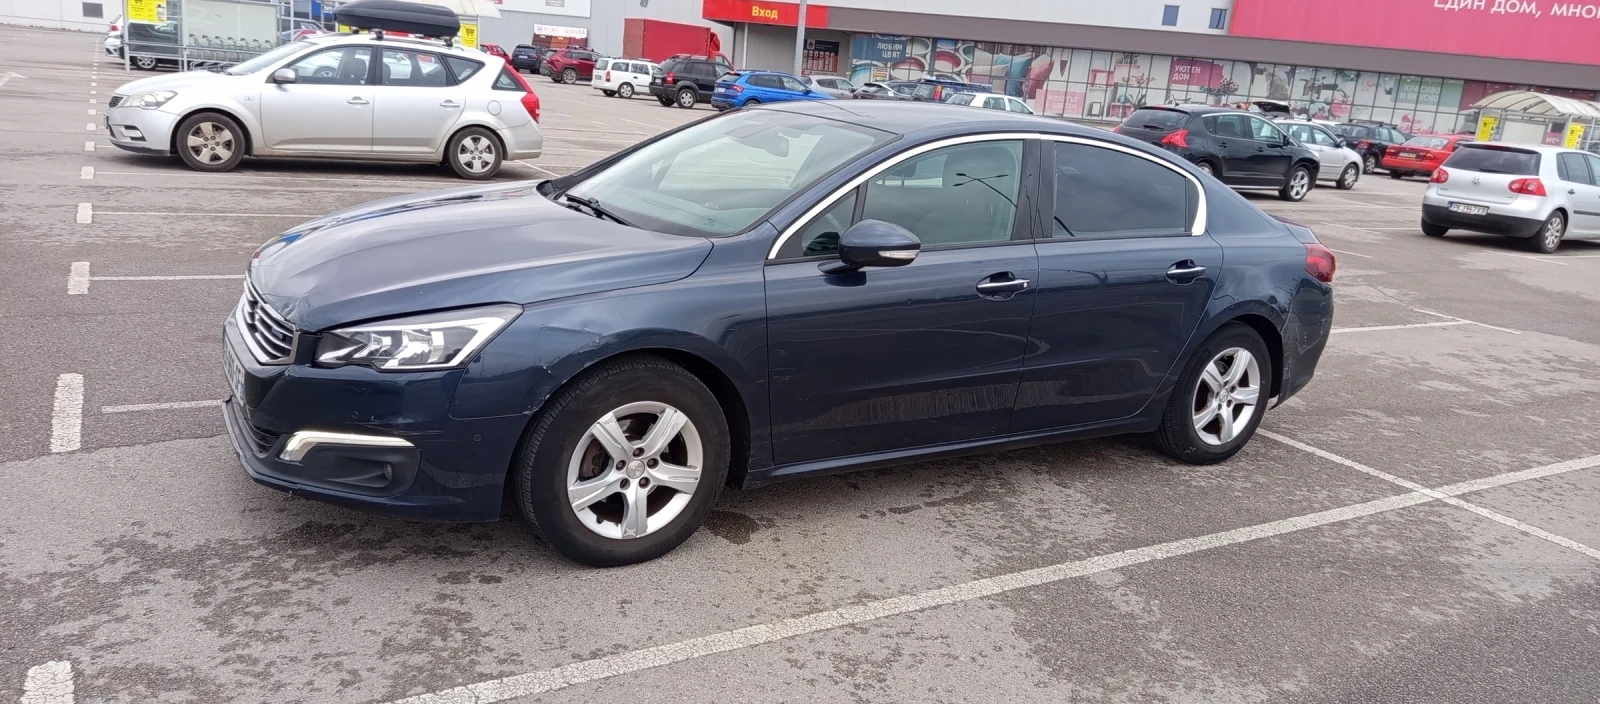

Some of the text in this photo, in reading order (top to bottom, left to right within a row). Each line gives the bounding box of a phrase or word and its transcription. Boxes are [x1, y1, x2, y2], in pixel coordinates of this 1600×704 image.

[752, 6, 778, 20] Вход
[1490, 0, 1542, 19] ДОМ,
[876, 42, 903, 51] ЛЮБИМ
[881, 50, 901, 59] ЦВЯТ
[1174, 65, 1201, 74] УЮТЕН
[1172, 72, 1190, 81] ДОМ
[1404, 84, 1441, 94] КРАСИВО
[1407, 92, 1439, 102] ВКУСНО
